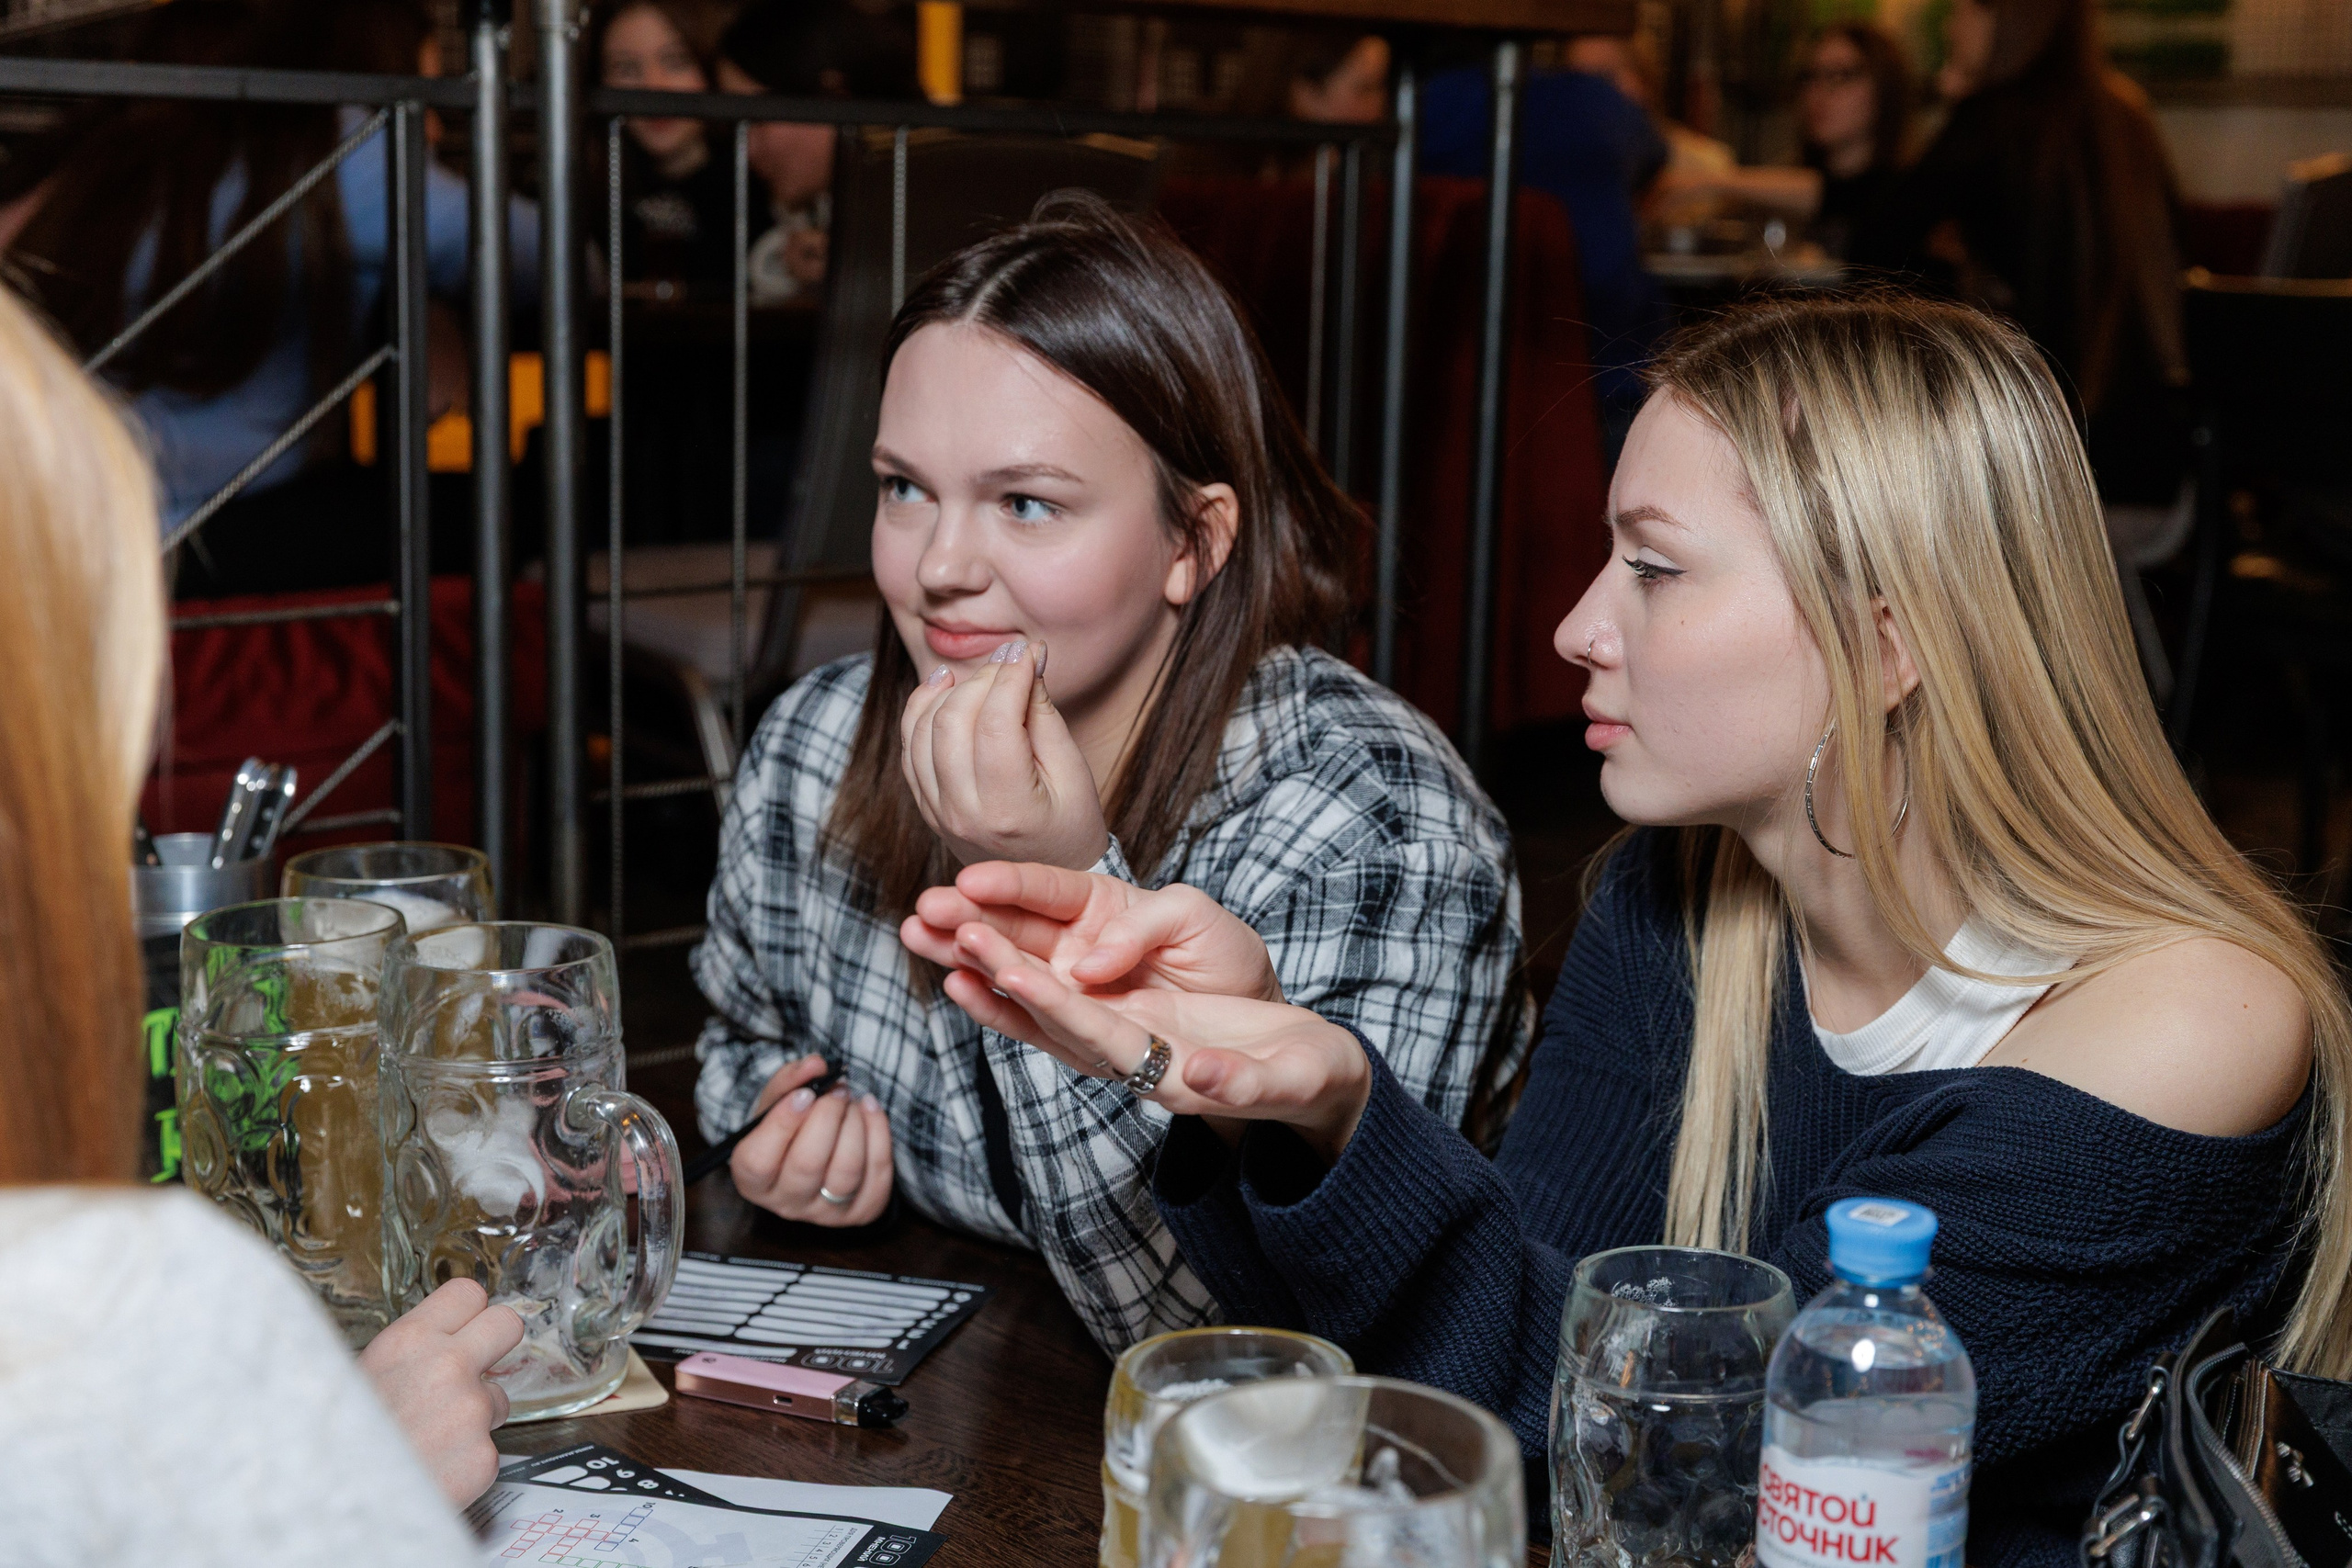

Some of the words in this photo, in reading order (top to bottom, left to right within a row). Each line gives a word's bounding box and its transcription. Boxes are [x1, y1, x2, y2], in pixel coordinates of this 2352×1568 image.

[800, 1352, 895, 1374] 100
[586, 1456, 620, 1470] 10
[616, 1468, 636, 1479] 9
[637, 1479, 660, 1490] 8
[1762, 1462, 1877, 1529] СВЯТОЙ
[642, 1501, 656, 1509] 10
[1757, 1495, 1900, 1564] СТОЧНИК
[856, 1536, 887, 1562] МНЕНИЙ
[868, 1534, 917, 1565] 100
